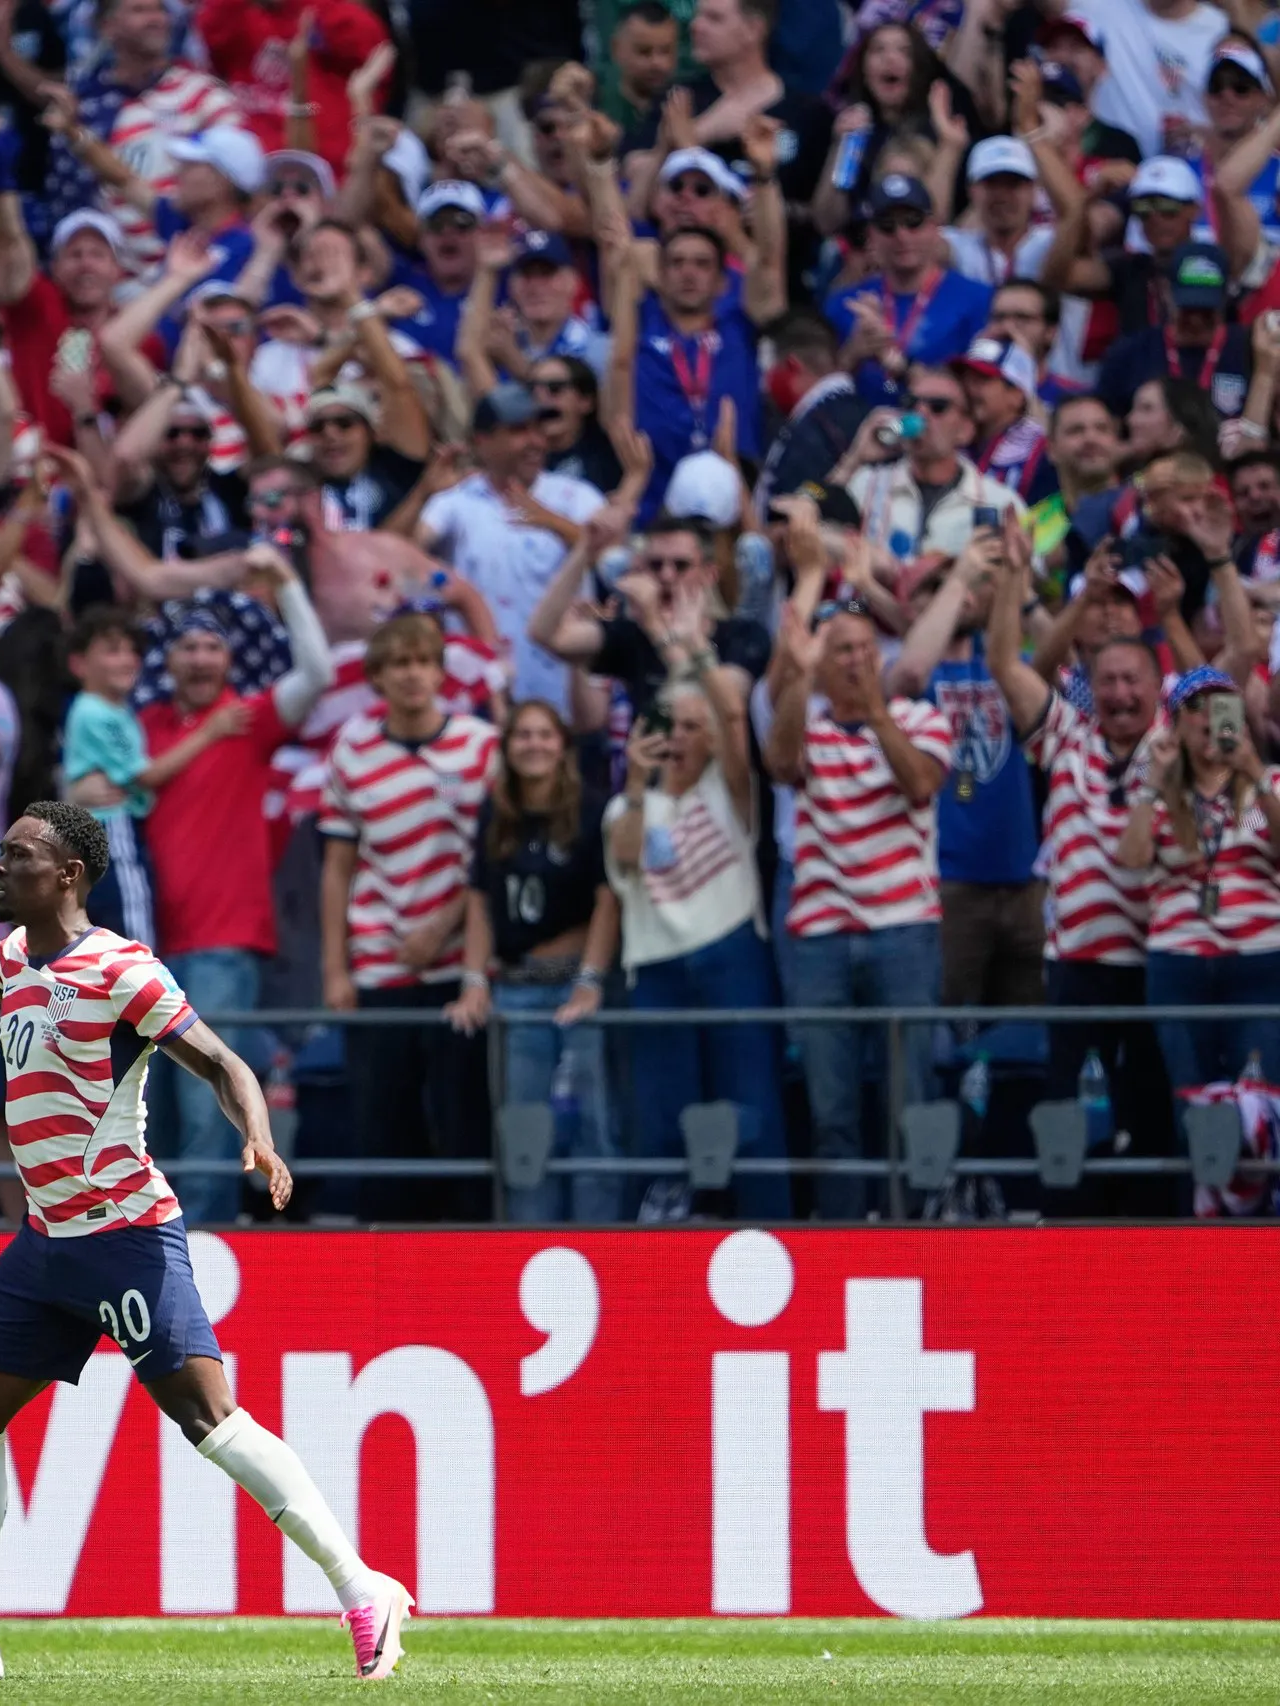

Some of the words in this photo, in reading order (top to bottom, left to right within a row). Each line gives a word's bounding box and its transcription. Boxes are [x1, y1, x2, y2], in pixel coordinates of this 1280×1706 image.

[506, 874, 546, 923] 10
[54, 984, 76, 1001] USA
[6, 1014, 35, 1070] 20
[99, 1288, 151, 1348] 20
[708, 1230, 984, 1619] it
